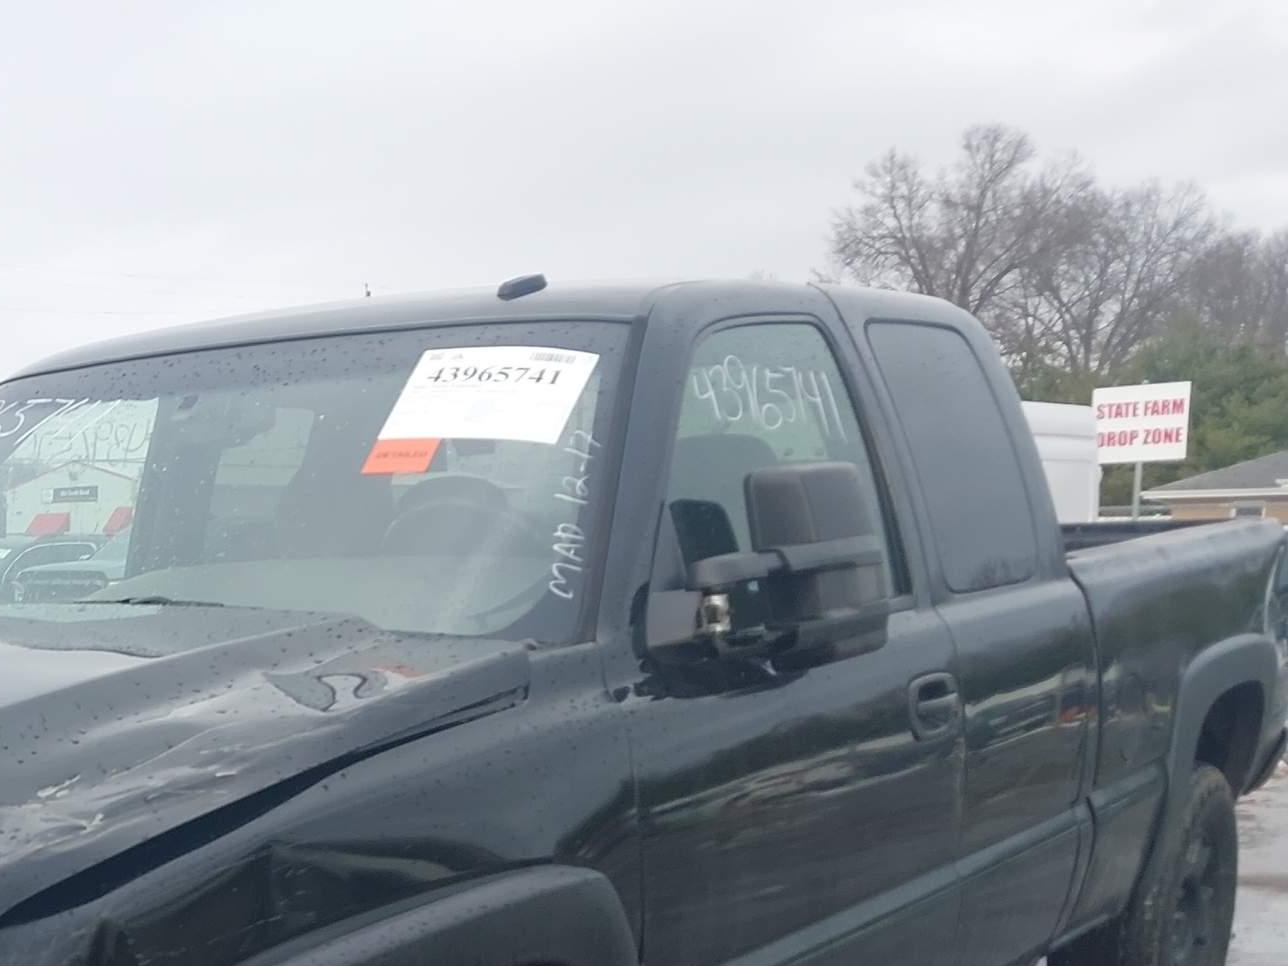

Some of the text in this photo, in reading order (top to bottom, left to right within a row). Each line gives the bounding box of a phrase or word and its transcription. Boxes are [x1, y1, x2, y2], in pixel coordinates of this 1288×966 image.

[426, 365, 561, 385] 43965741
[689, 354, 848, 442] 43965741
[1096, 398, 1185, 420] STATE FARM
[1096, 427, 1184, 448] DROP ZONE
[549, 429, 602, 599] MAD 12-17
